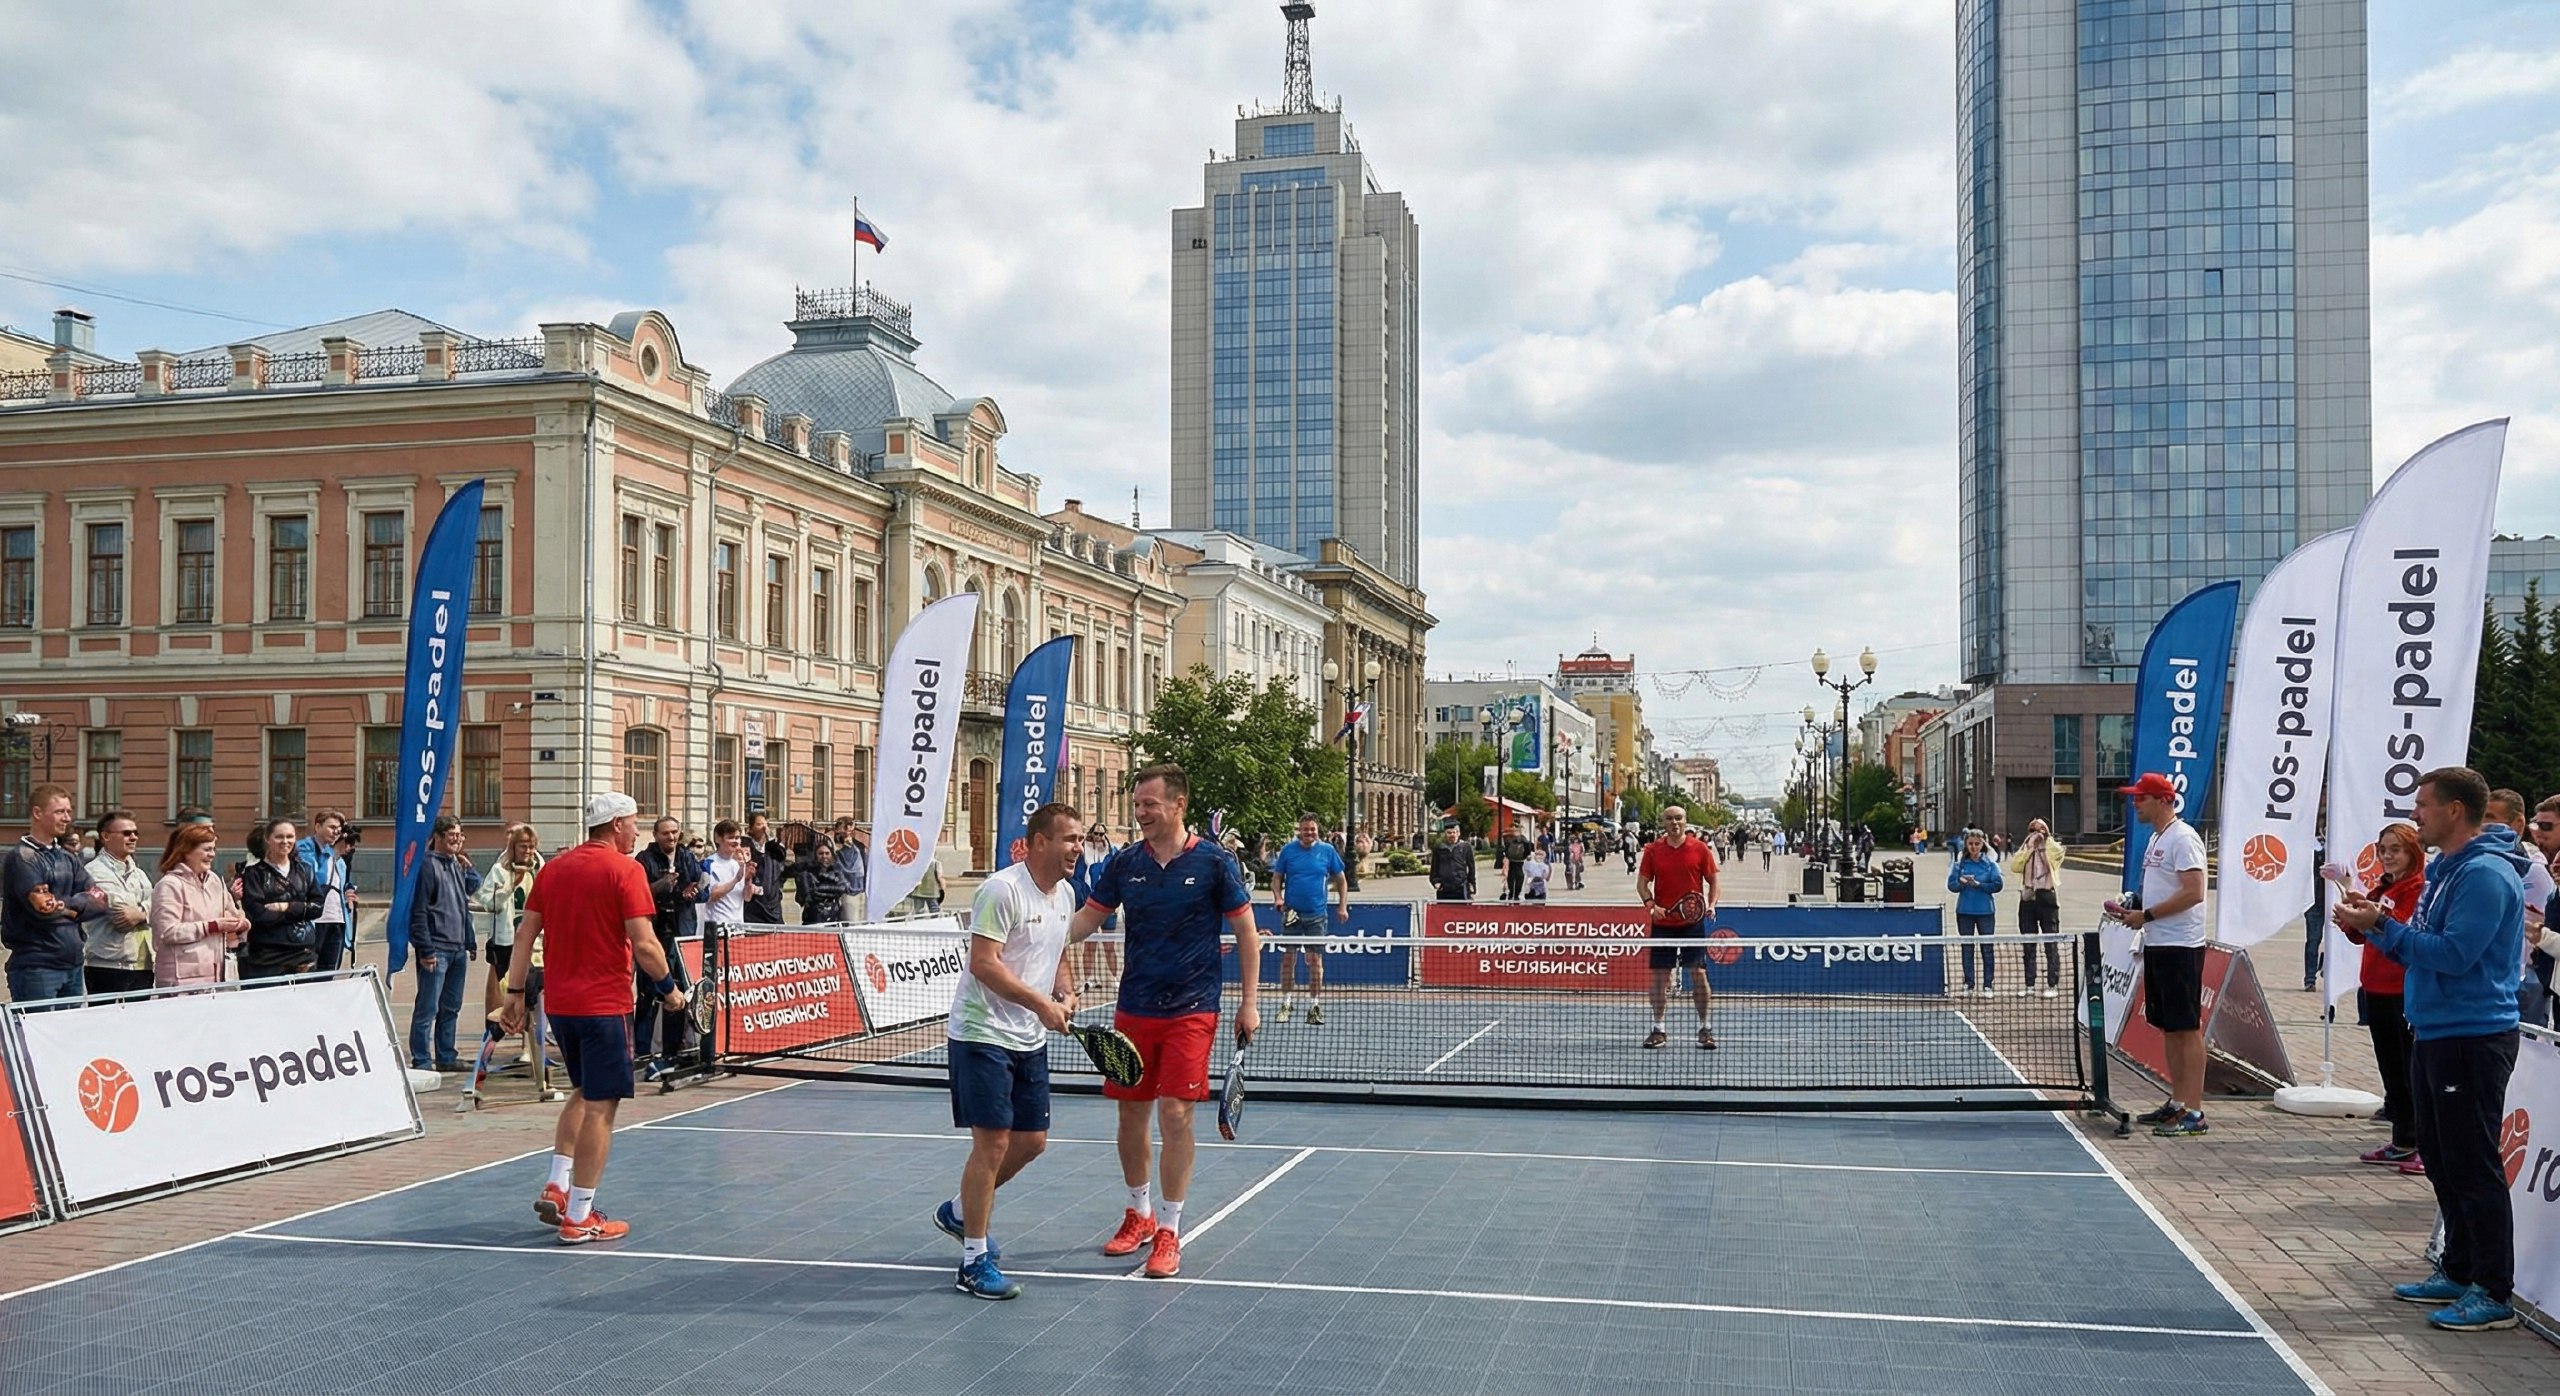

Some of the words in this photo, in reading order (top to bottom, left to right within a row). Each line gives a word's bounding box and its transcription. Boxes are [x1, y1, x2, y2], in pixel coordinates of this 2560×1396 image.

[2383, 548, 2442, 818] ros-padel
[416, 590, 450, 823] ros-padel
[2265, 617, 2317, 820] ros-padel
[904, 658, 941, 817] ros-padel
[2166, 658, 2199, 814] os-padel
[1444, 921, 1498, 935] СЕРИЯ
[1502, 922, 1645, 937] ЛЮБИТЕЛЬСКИХ
[888, 947, 963, 985] ros-padel
[1448, 943, 1536, 955] ТУРНИРОВ
[1541, 944, 1565, 955] ПО
[1754, 933, 1923, 968] ros-padel
[744, 953, 838, 982] ЛЮБИТЕЛЬСКИХ
[1479, 960, 1490, 973] В
[1495, 960, 1608, 975] ЧЕЛЯБИНСКЕ
[778, 982, 796, 1003] ПО
[796, 975, 840, 998] ПАДЕЛУ
[743, 1015, 754, 1033] В
[754, 1001, 830, 1030] ЧЕЛЯБИНСКЕ
[154, 1030, 371, 1108] ros-padel
